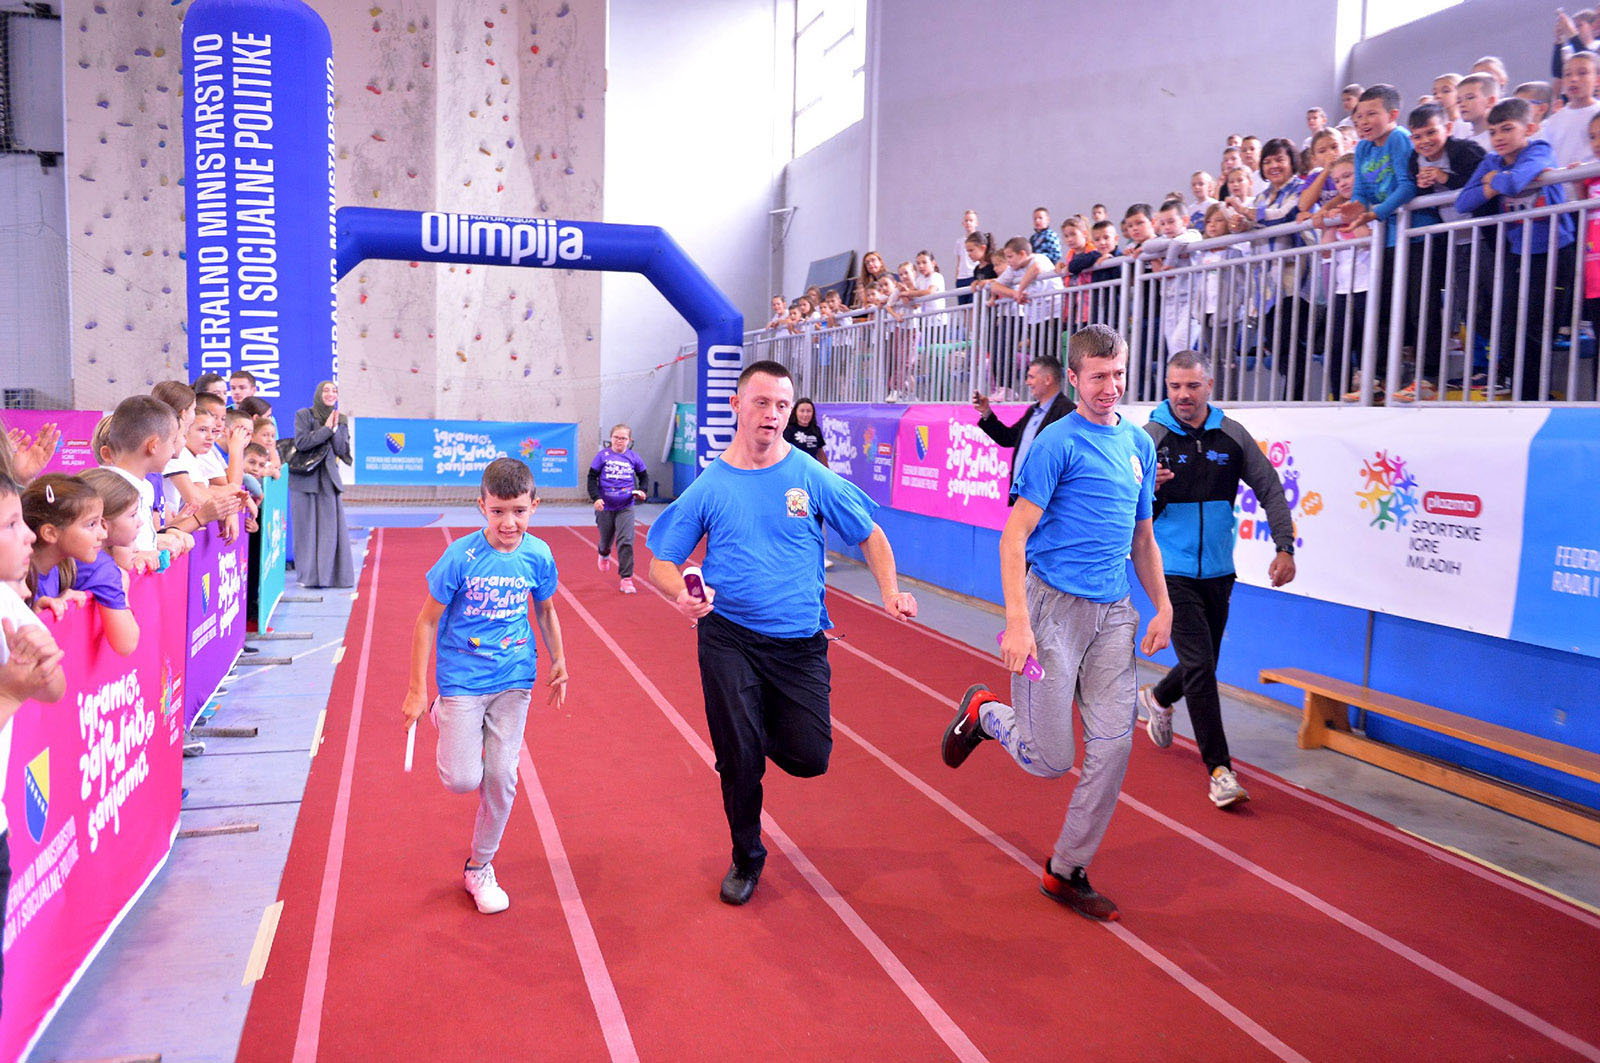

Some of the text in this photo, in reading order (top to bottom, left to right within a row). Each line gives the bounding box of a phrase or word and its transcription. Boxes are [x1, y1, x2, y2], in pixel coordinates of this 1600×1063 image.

[232, 31, 274, 150] POLITIKE
[193, 33, 228, 238] MINISTARSTVO
[235, 157, 278, 302] SOCIJALNE
[470, 215, 537, 224] NATURAQUA
[421, 212, 583, 266] Olimpija
[240, 325, 280, 398] RADA
[699, 344, 743, 469] Olimp
[436, 458, 491, 478] sanjam
[1425, 494, 1476, 513] plazma
[1412, 519, 1482, 541] SPORTSKE
[1409, 537, 1440, 554] IGRE
[1405, 554, 1463, 576] MLADIH
[1552, 570, 1591, 597] RADA
